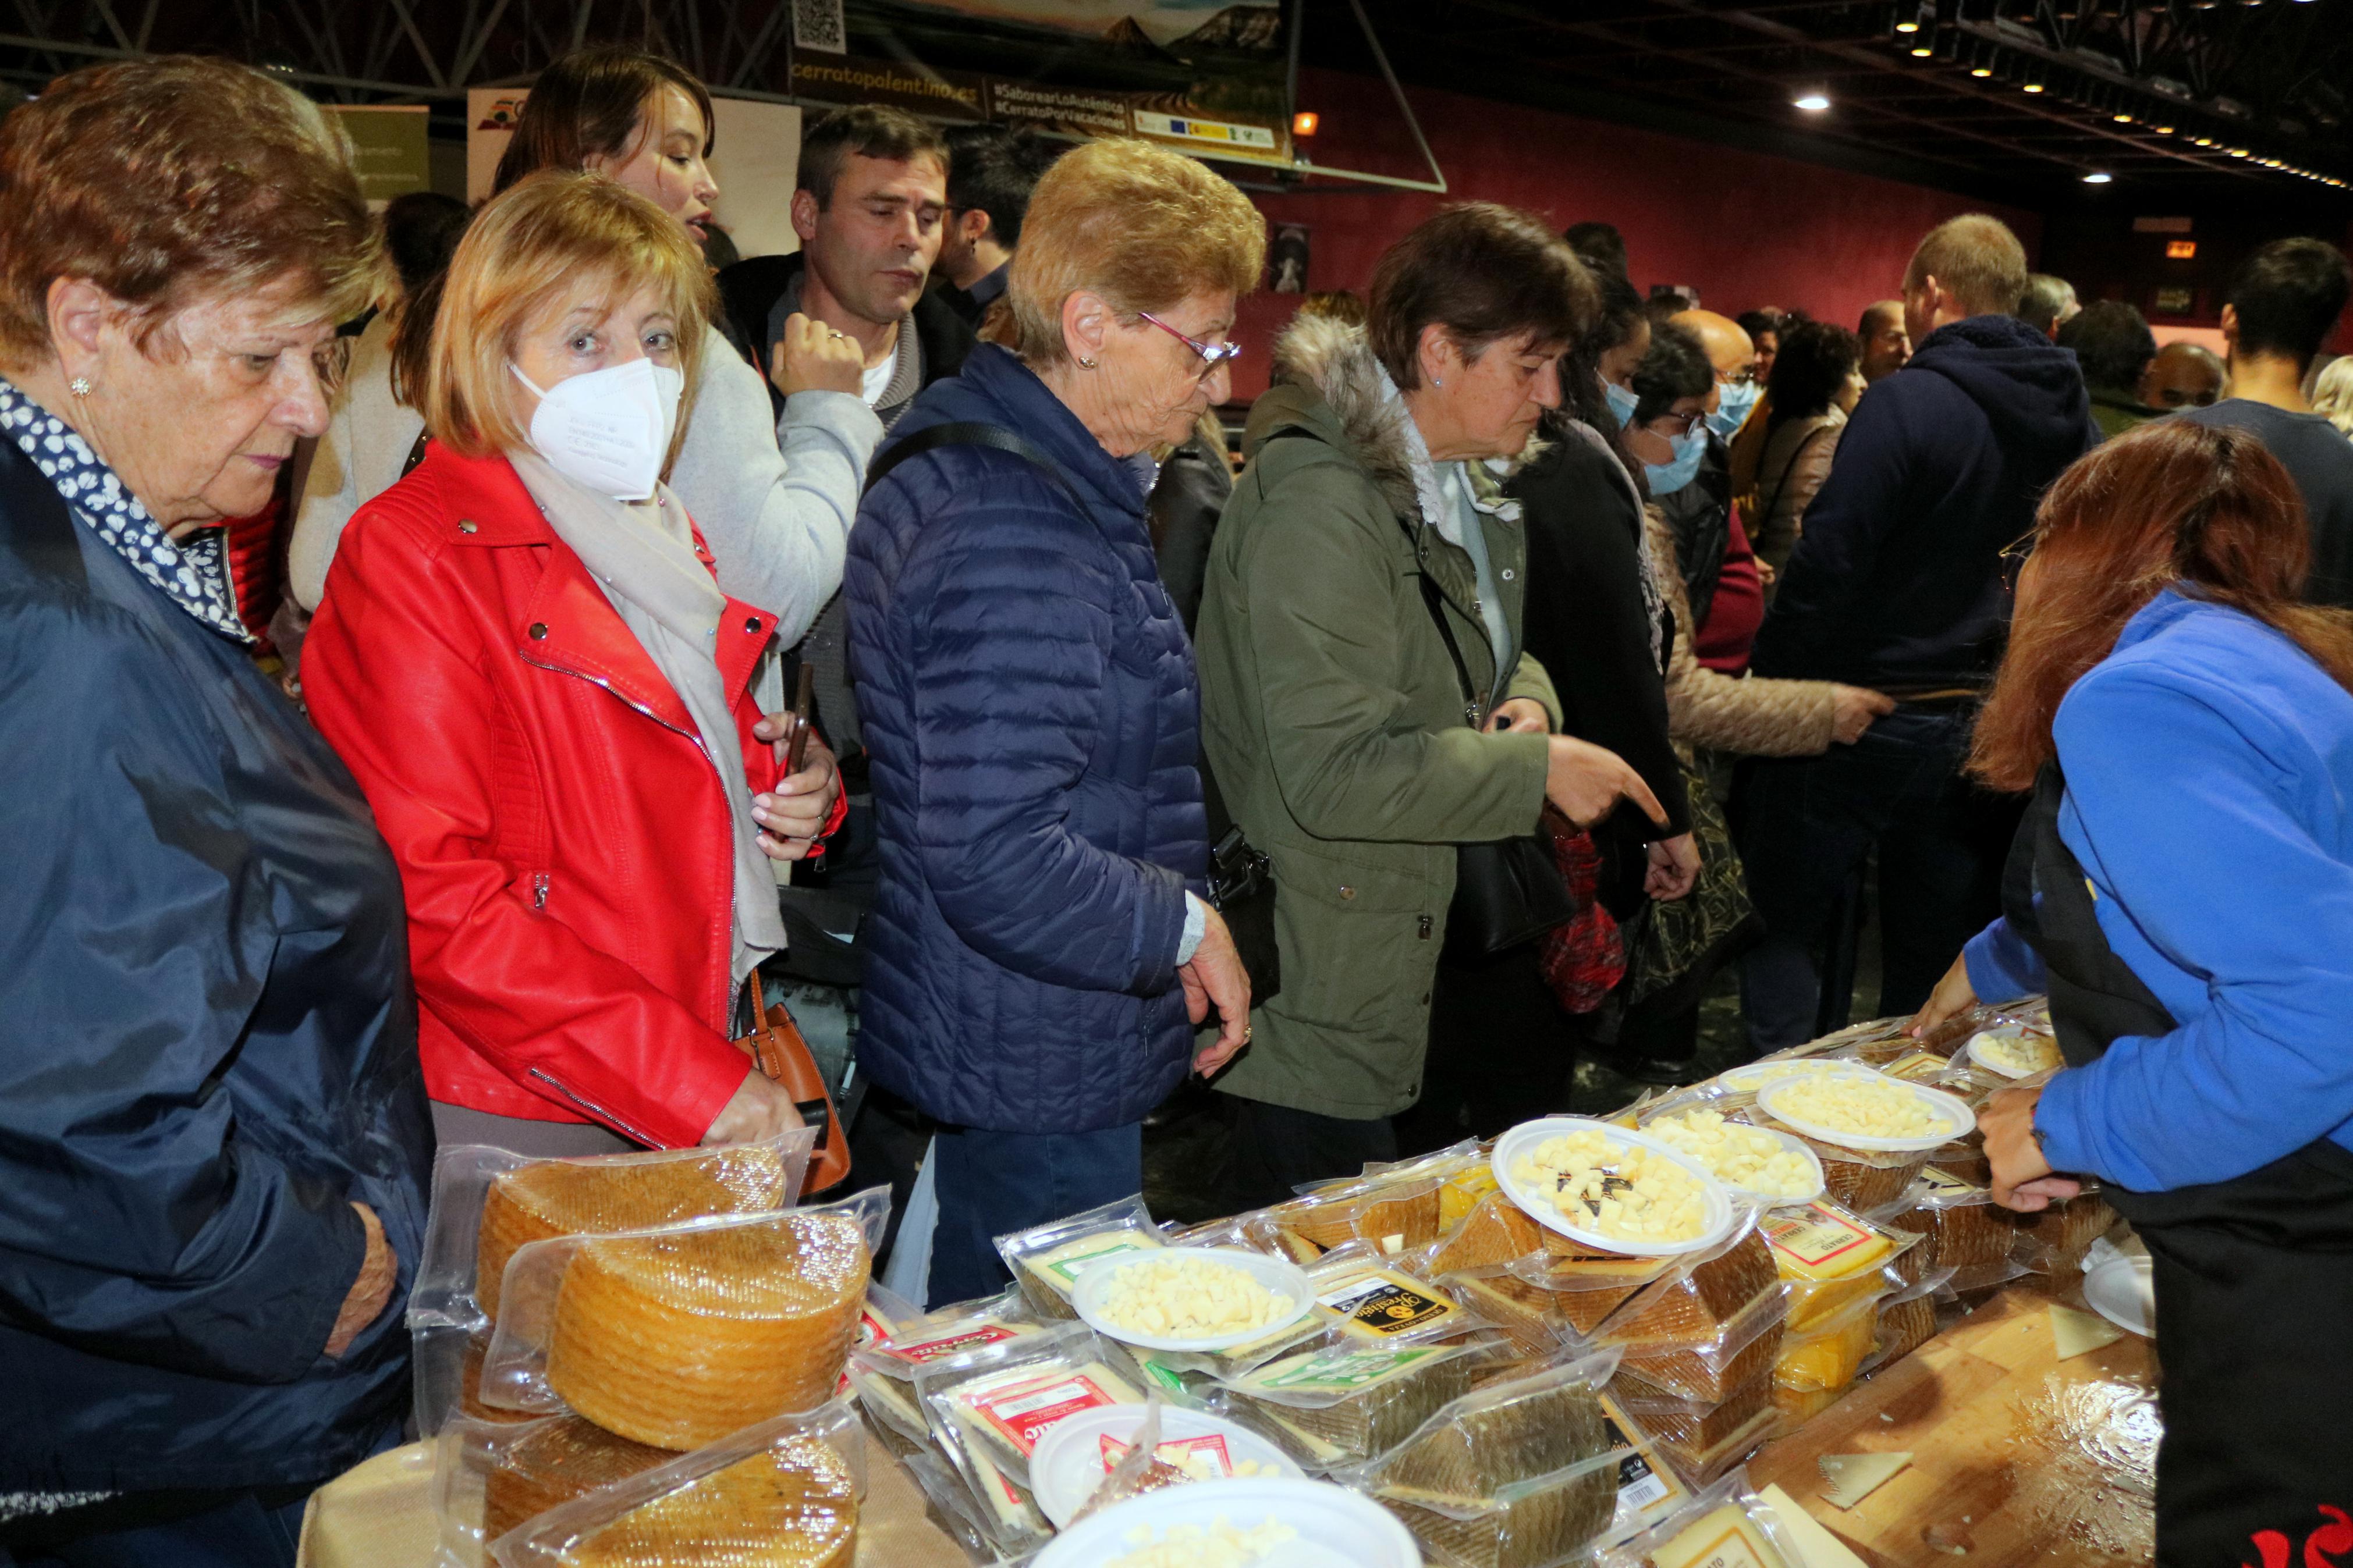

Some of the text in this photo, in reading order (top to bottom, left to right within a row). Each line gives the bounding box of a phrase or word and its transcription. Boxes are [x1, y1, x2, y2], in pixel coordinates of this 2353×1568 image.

[791, 63, 977, 102] cerratopalentino.es
[994, 84, 1125, 115] #SaborearLoAuténtico
[995, 101, 1126, 130] #CerratoPorVacaciones
[1773, 1226, 1806, 1242] CERRATO
[1821, 1233, 1854, 1250] CERRATO
[1356, 1292, 1422, 1317] Prestigio
[1418, 1309, 1443, 1321] QUESO
[1389, 1320, 1416, 1331] OVEJA
